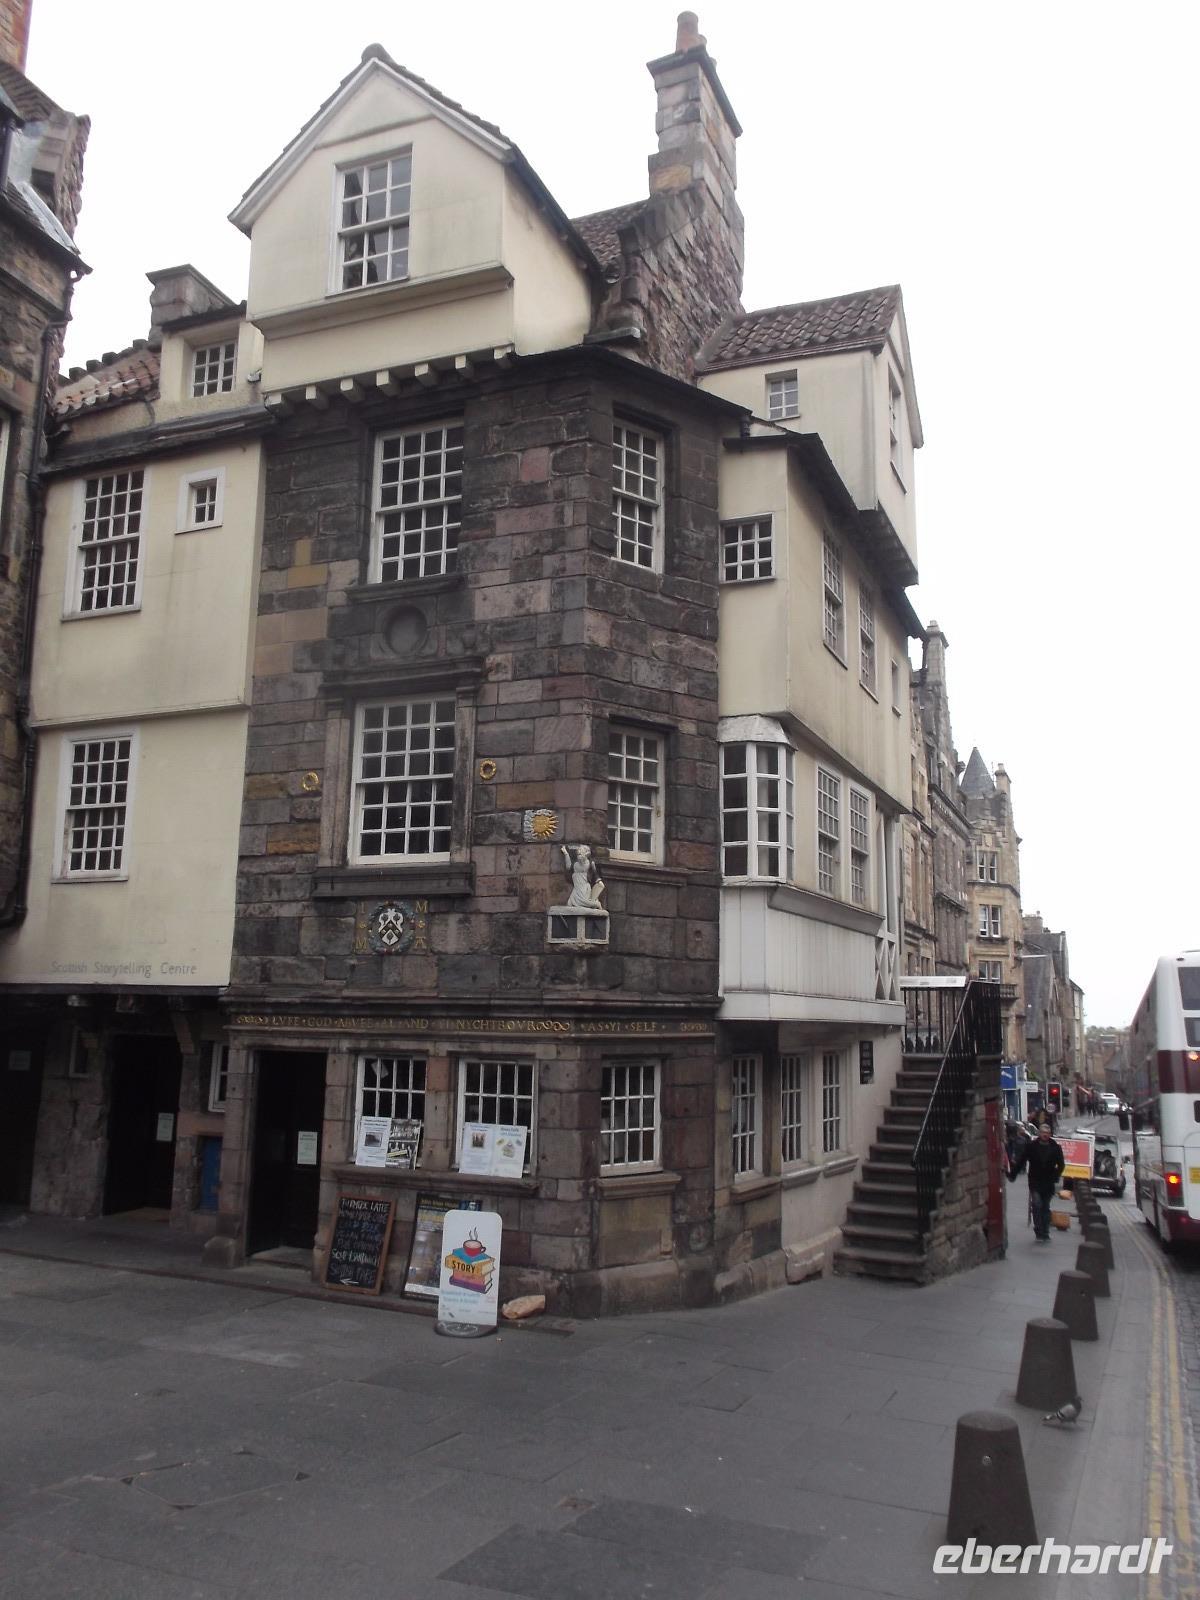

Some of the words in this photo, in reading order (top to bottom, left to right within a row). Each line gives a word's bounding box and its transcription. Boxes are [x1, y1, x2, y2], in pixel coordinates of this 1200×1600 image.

[415, 900, 428, 913] M
[51, 961, 88, 974] Scottish
[93, 961, 152, 979] Storytelling
[160, 961, 198, 975] Centre
[306, 1017, 332, 1028] GOD
[629, 1021, 658, 1032] SELF
[452, 1260, 476, 1274] STORY
